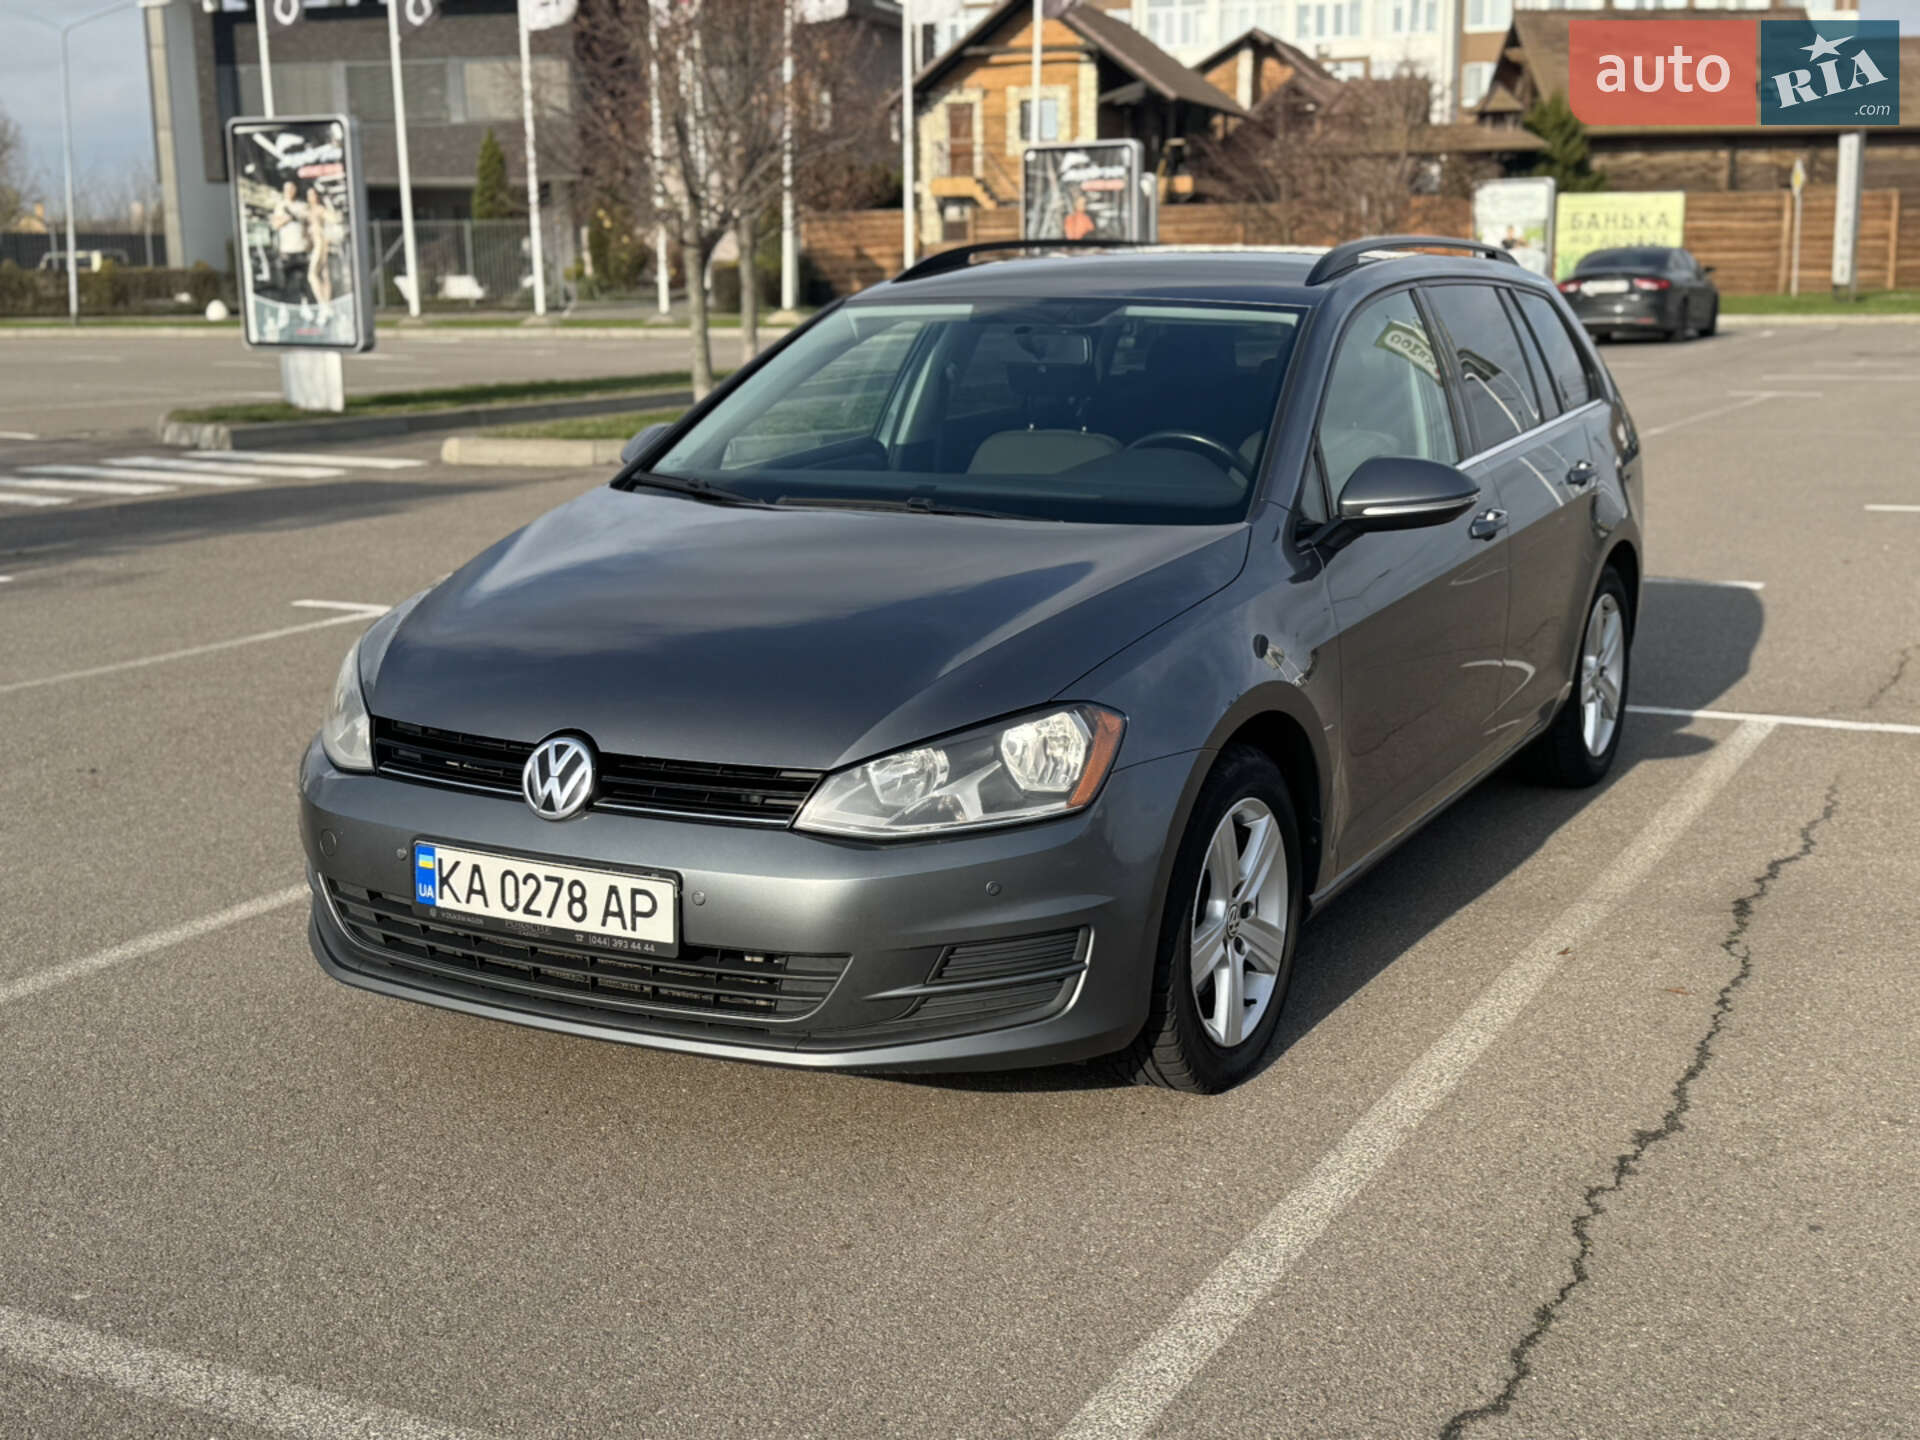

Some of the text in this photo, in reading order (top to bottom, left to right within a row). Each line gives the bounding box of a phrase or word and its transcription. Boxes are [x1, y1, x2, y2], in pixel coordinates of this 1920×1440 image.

[1570, 211, 1671, 231] БАНЬКА
[418, 882, 434, 898] UA
[438, 857, 658, 932] KA 0278 AP
[612, 938, 628, 949] 393
[630, 942, 641, 951] 44
[643, 944, 655, 953] 44
